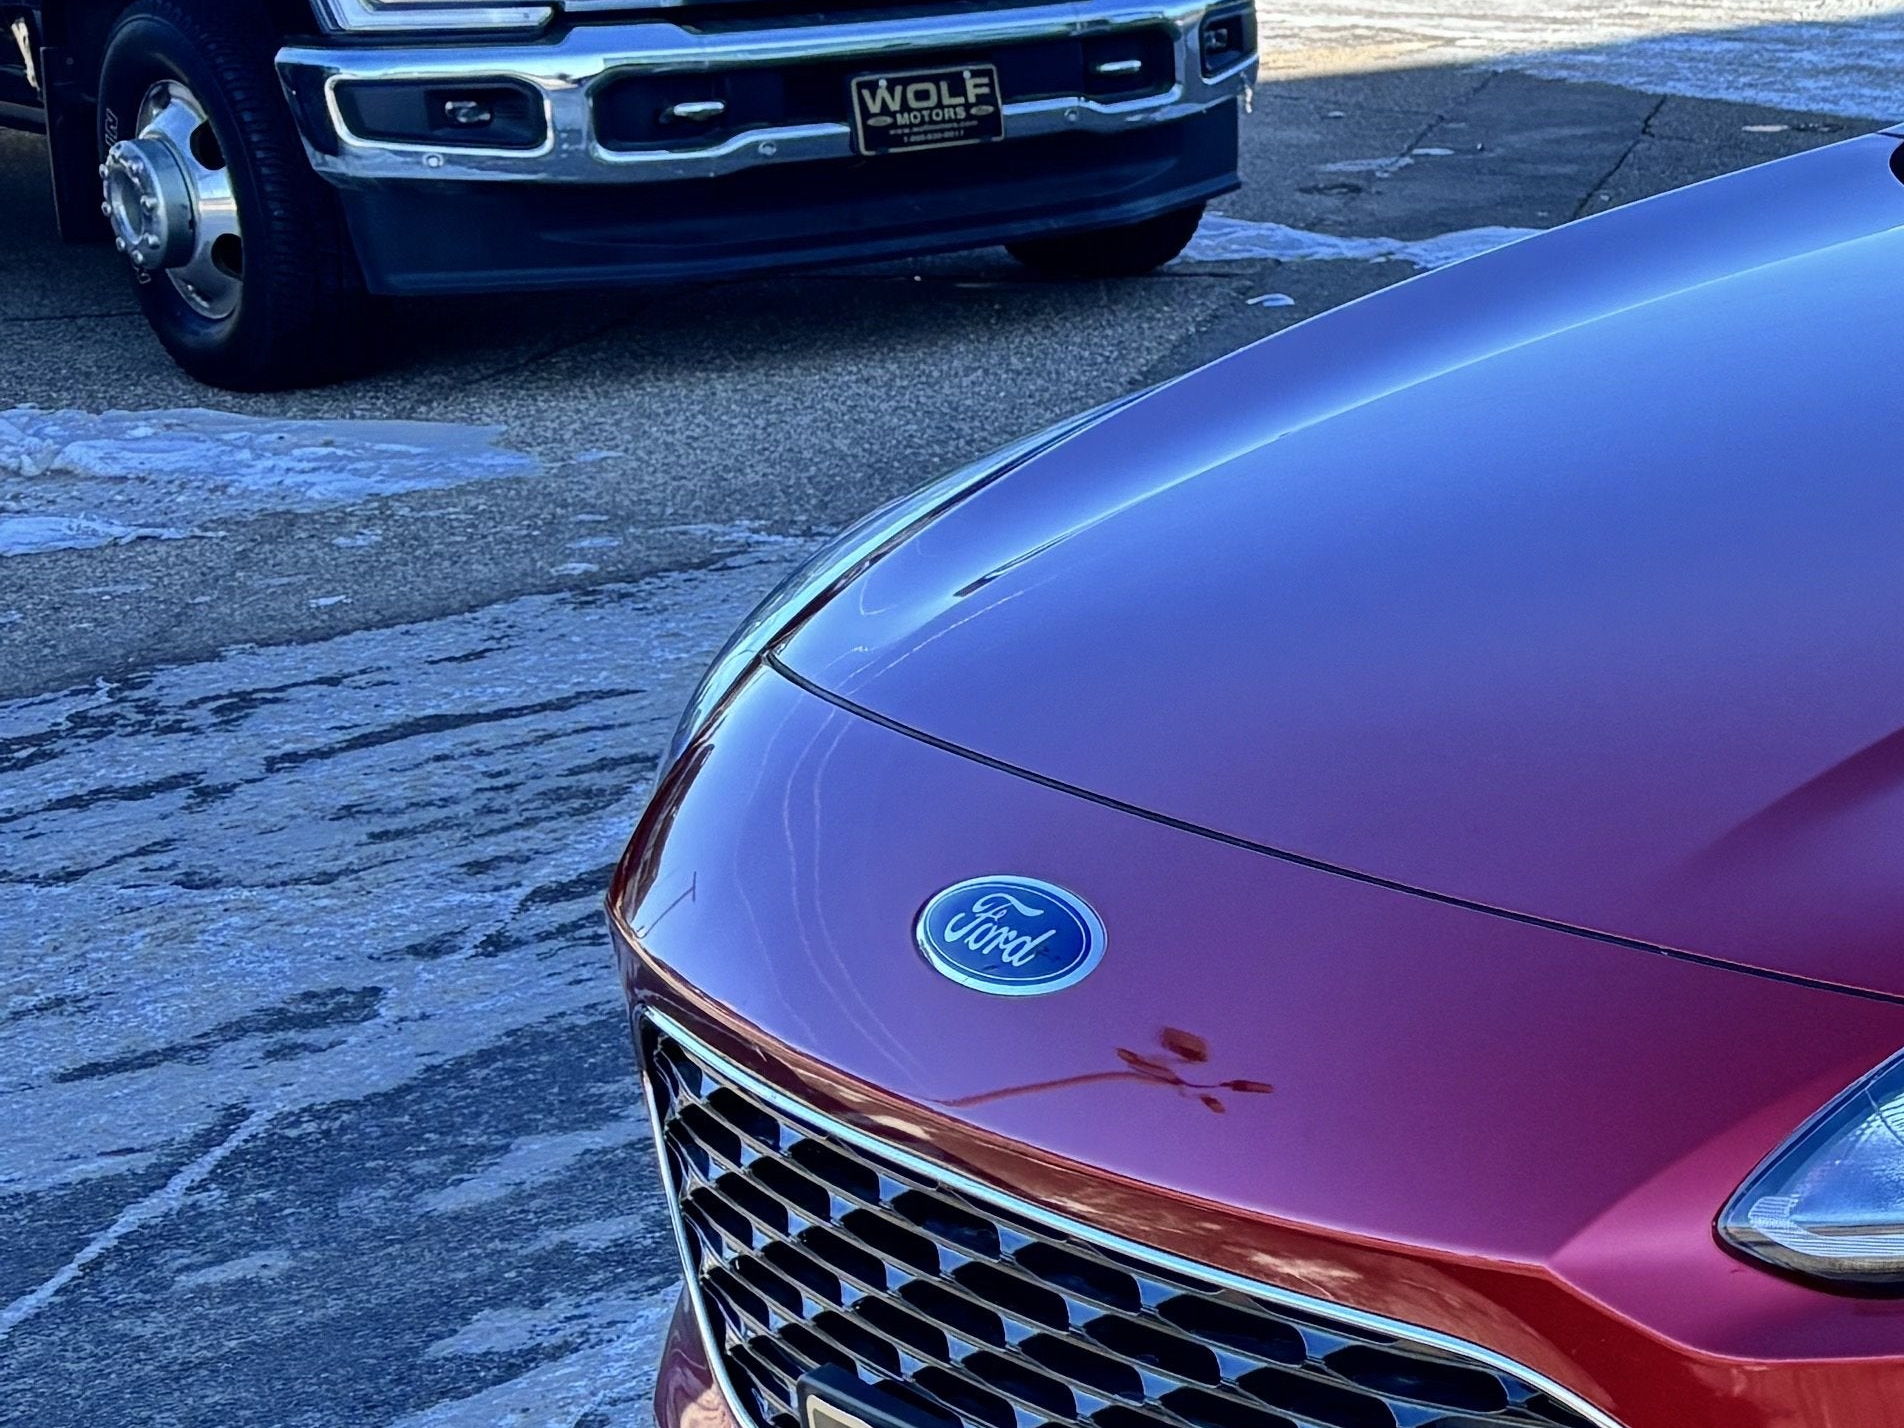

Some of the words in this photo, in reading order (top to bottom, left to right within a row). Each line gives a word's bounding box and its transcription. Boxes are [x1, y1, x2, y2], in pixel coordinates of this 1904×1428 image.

[861, 76, 991, 114] WOLF
[896, 106, 966, 126] MOTORS
[944, 892, 1057, 967] Ford
